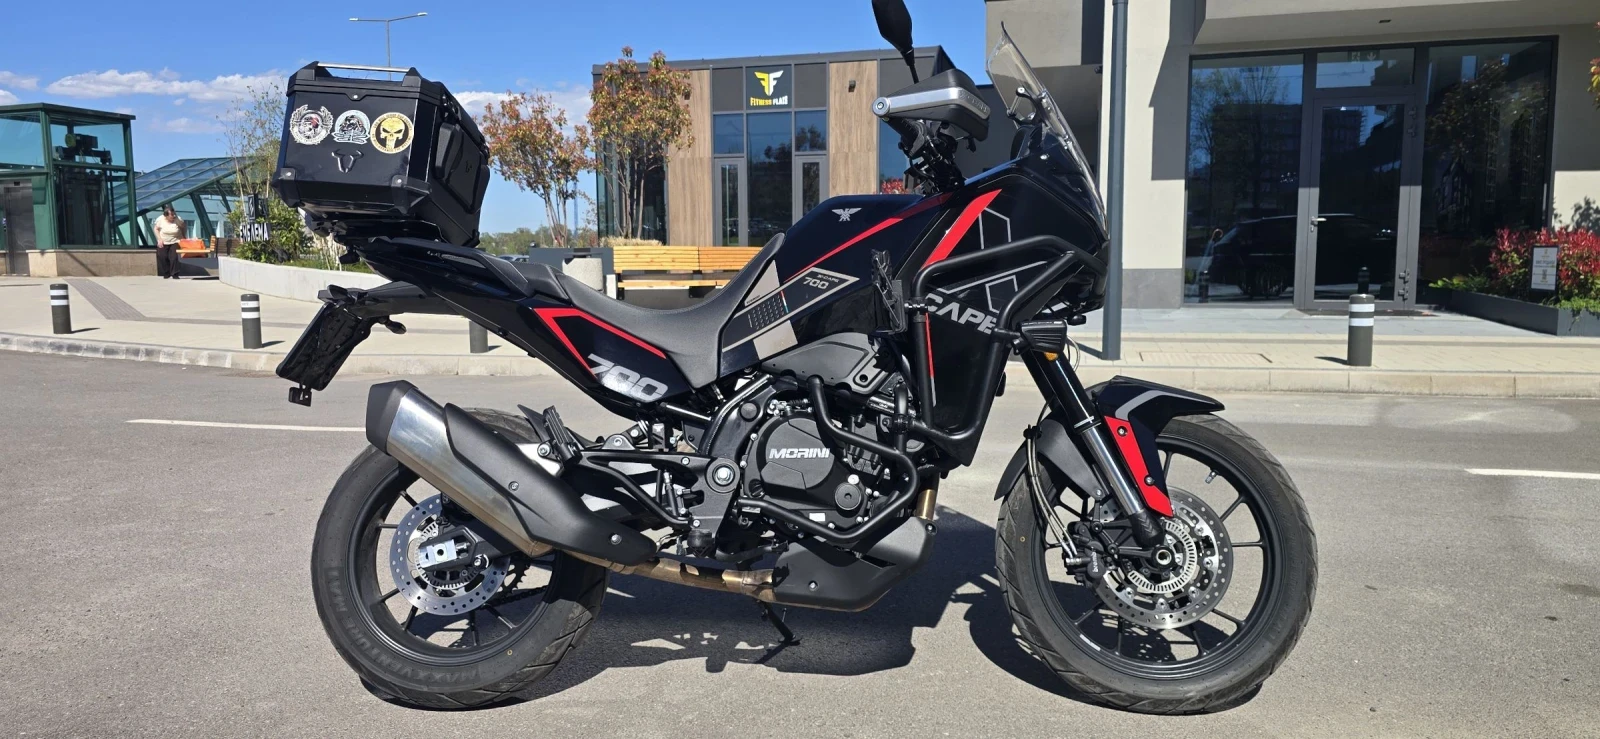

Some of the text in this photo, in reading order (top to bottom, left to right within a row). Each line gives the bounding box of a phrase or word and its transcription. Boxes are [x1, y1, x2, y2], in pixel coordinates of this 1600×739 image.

[803, 277, 829, 289] 700
[588, 353, 668, 402] 700
[770, 448, 830, 459] MORINI
